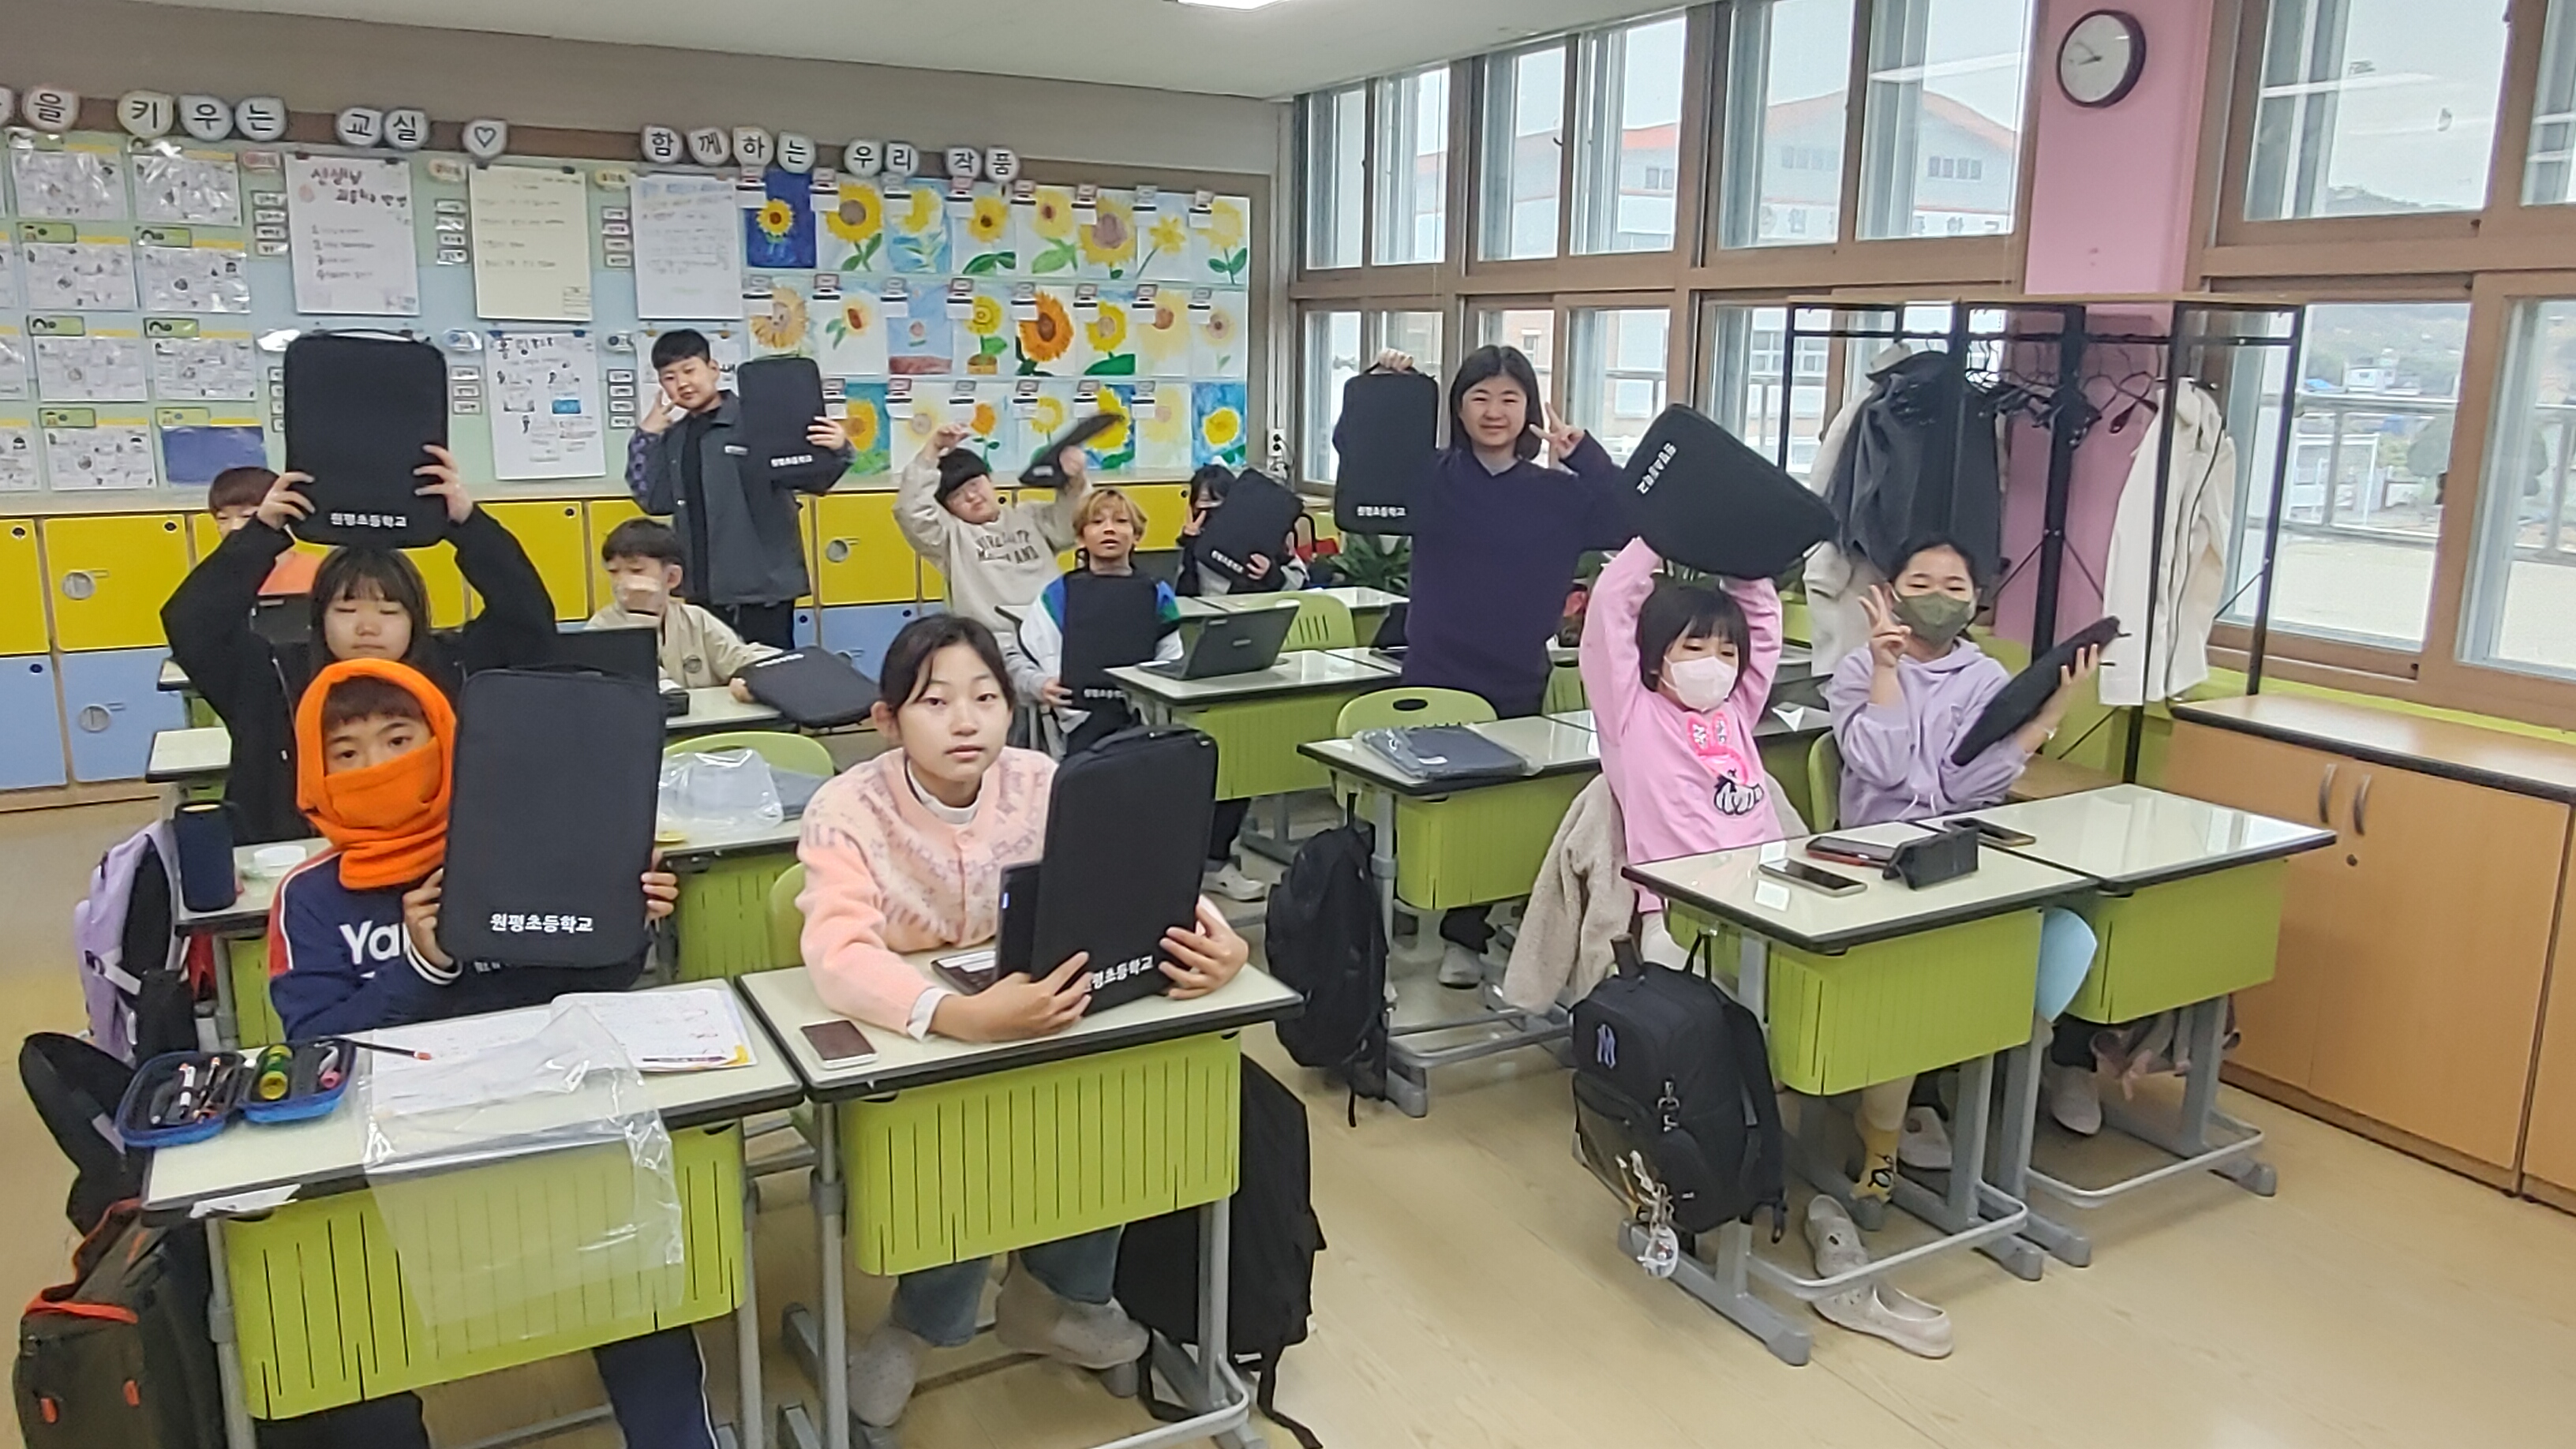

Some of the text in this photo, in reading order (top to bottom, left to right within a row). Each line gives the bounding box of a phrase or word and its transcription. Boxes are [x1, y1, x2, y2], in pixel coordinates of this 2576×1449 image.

[131, 100, 275, 131] 키우는
[346, 113, 417, 142] 교실
[651, 131, 1012, 175] 함께하는 우리 작품
[339, 920, 410, 965] Ya
[490, 912, 593, 934] 원평초등학교
[1088, 954, 1154, 990] 평초등학교
